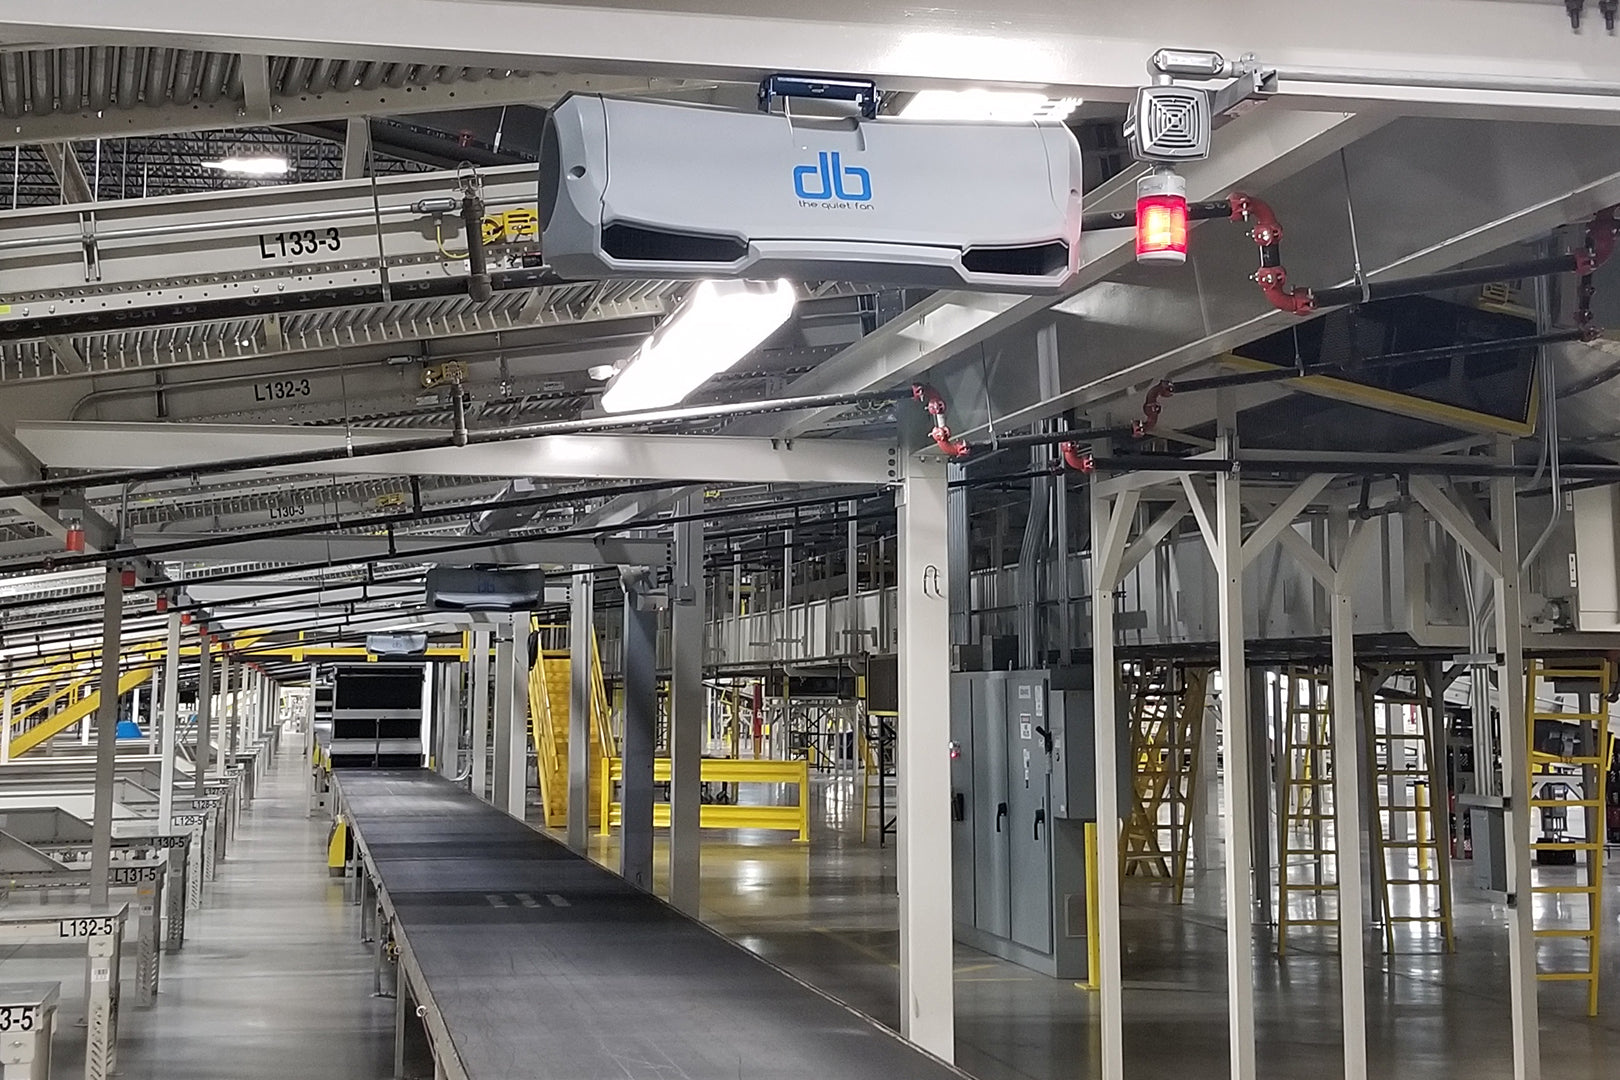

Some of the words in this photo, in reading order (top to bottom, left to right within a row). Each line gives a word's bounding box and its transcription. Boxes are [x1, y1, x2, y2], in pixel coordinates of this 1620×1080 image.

[793, 151, 872, 201] db
[798, 200, 818, 208] the
[821, 202, 851, 210] quiet
[854, 202, 874, 210] fan
[259, 227, 341, 260] L133-3
[254, 379, 311, 402] L132-3
[269, 504, 304, 521] L130-3
[174, 815, 203, 826] L129-5
[151, 837, 185, 849] L130-5
[115, 868, 156, 882] L131-5
[60, 918, 113, 937] L132-5
[0, 1007, 34, 1031] 3-5
